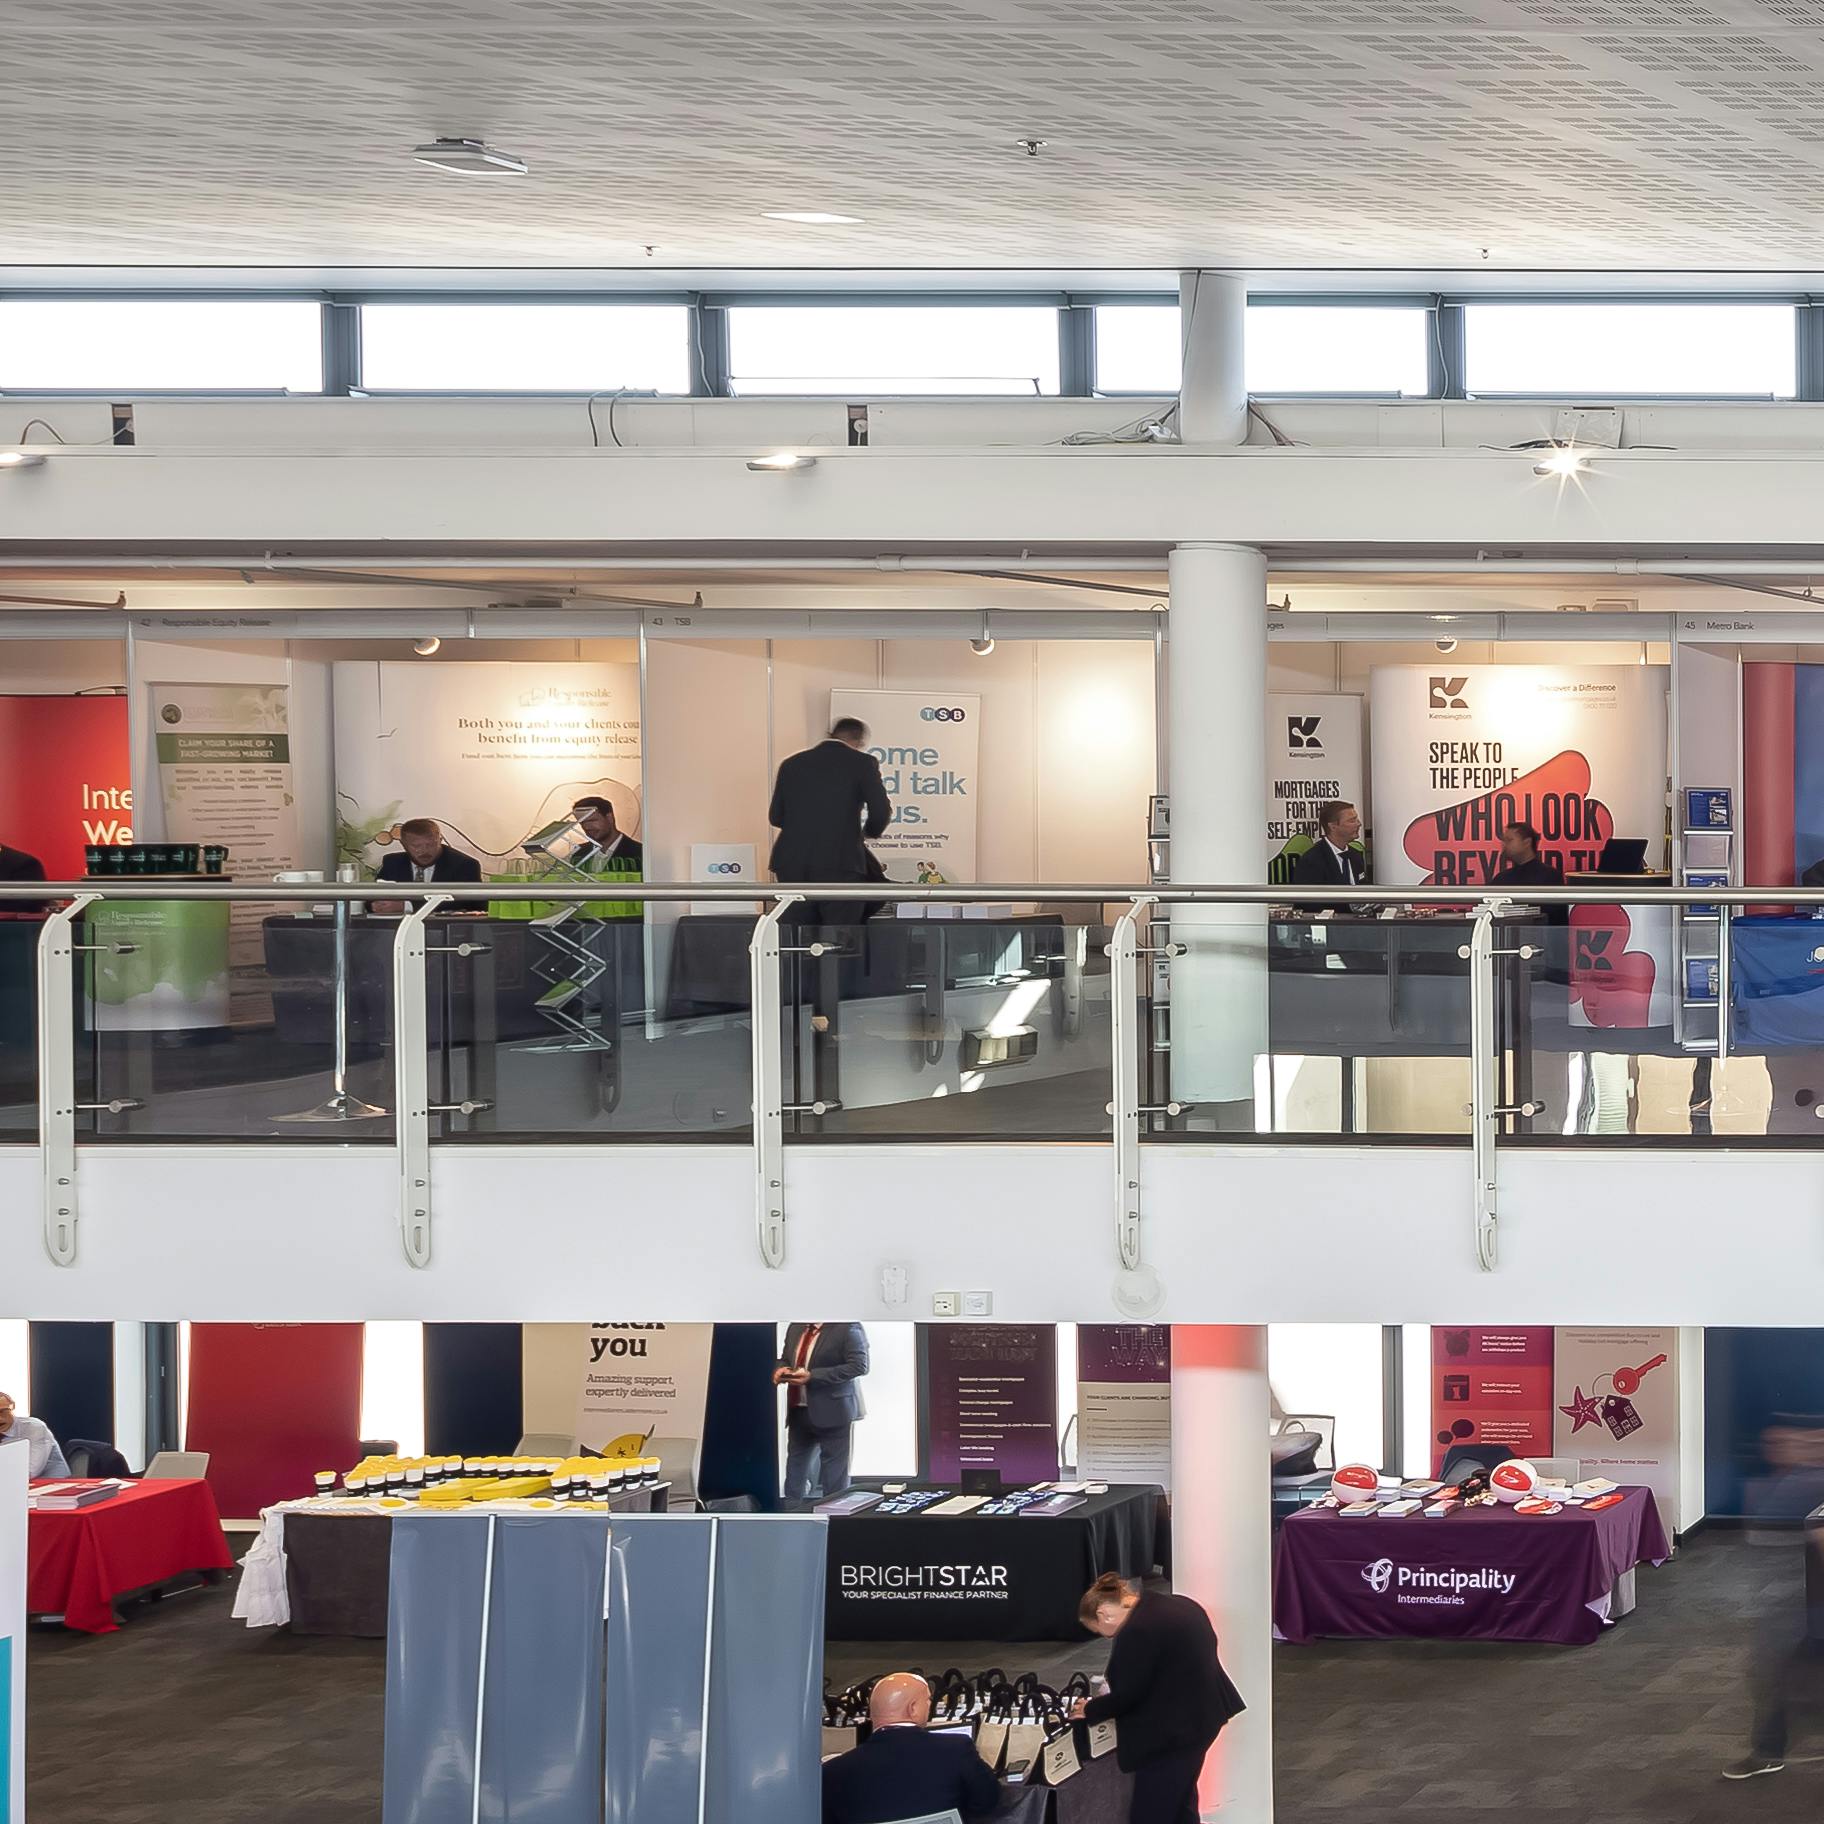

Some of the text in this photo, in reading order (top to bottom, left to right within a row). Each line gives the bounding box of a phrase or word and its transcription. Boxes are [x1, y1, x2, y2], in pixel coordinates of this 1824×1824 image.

[1430, 742, 1502, 763] SPEAK TO
[910, 771, 967, 795] talk
[1275, 781, 1339, 798] MORTGAGES
[590, 1338, 647, 1362] you
[587, 1374, 674, 1386] Amazing support,
[586, 1388, 676, 1398] expertly delivered
[841, 1566, 1008, 1586] BRIGHTSTAR
[1398, 1567, 1516, 1593] Principality
[842, 1591, 1008, 1599] YOUR SPECIALIST FINANCE PARTNER
[1398, 1594, 1464, 1605] Intermediaries
